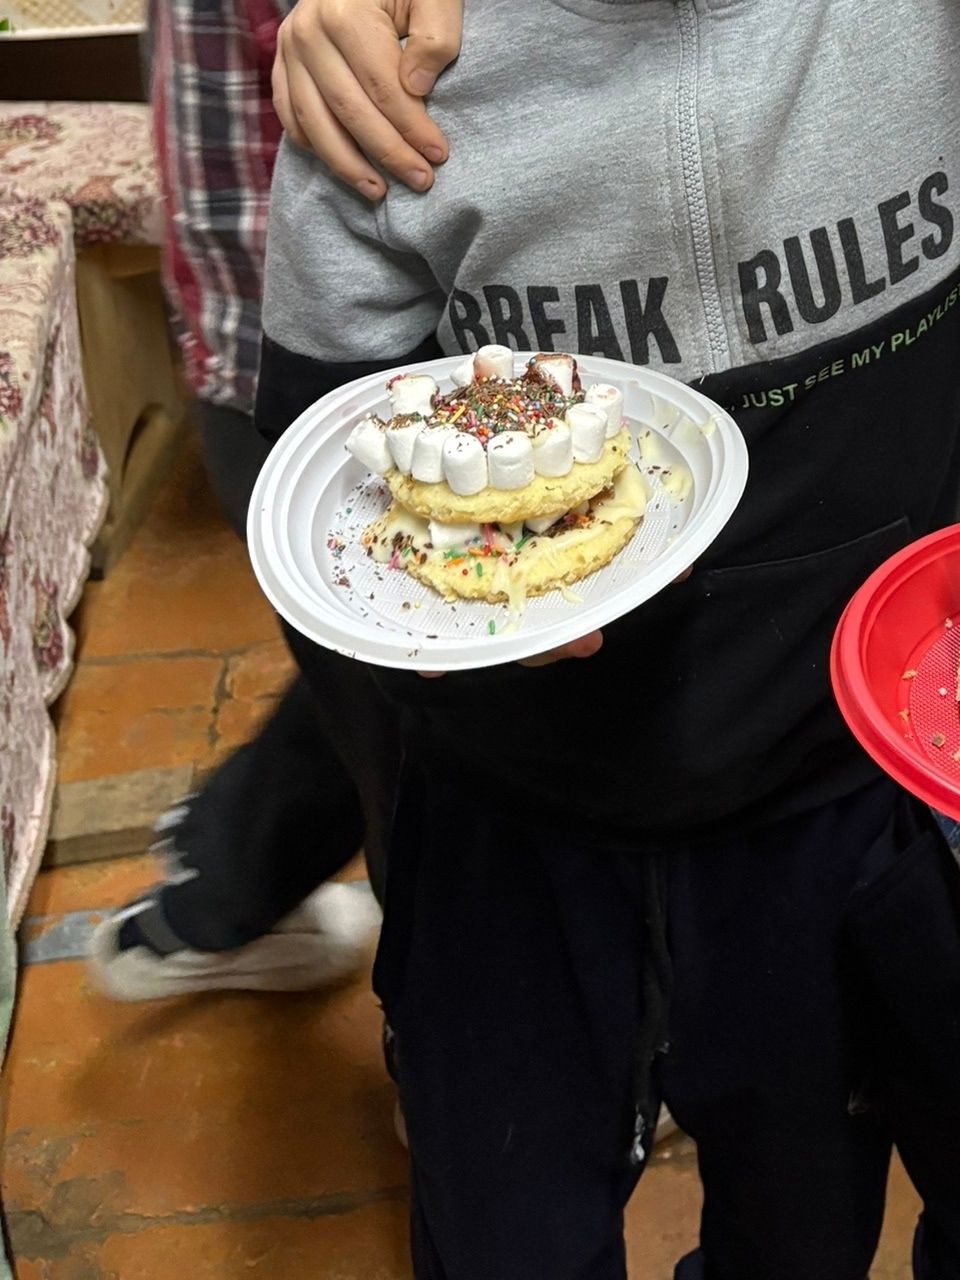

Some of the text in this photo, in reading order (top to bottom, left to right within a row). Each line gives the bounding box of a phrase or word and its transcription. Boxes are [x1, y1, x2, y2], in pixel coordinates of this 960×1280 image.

[449, 170, 955, 365] BREAK RULES
[742, 383, 799, 408] JUST
[804, 359, 845, 390] SEE
[851, 342, 887, 369] MY
